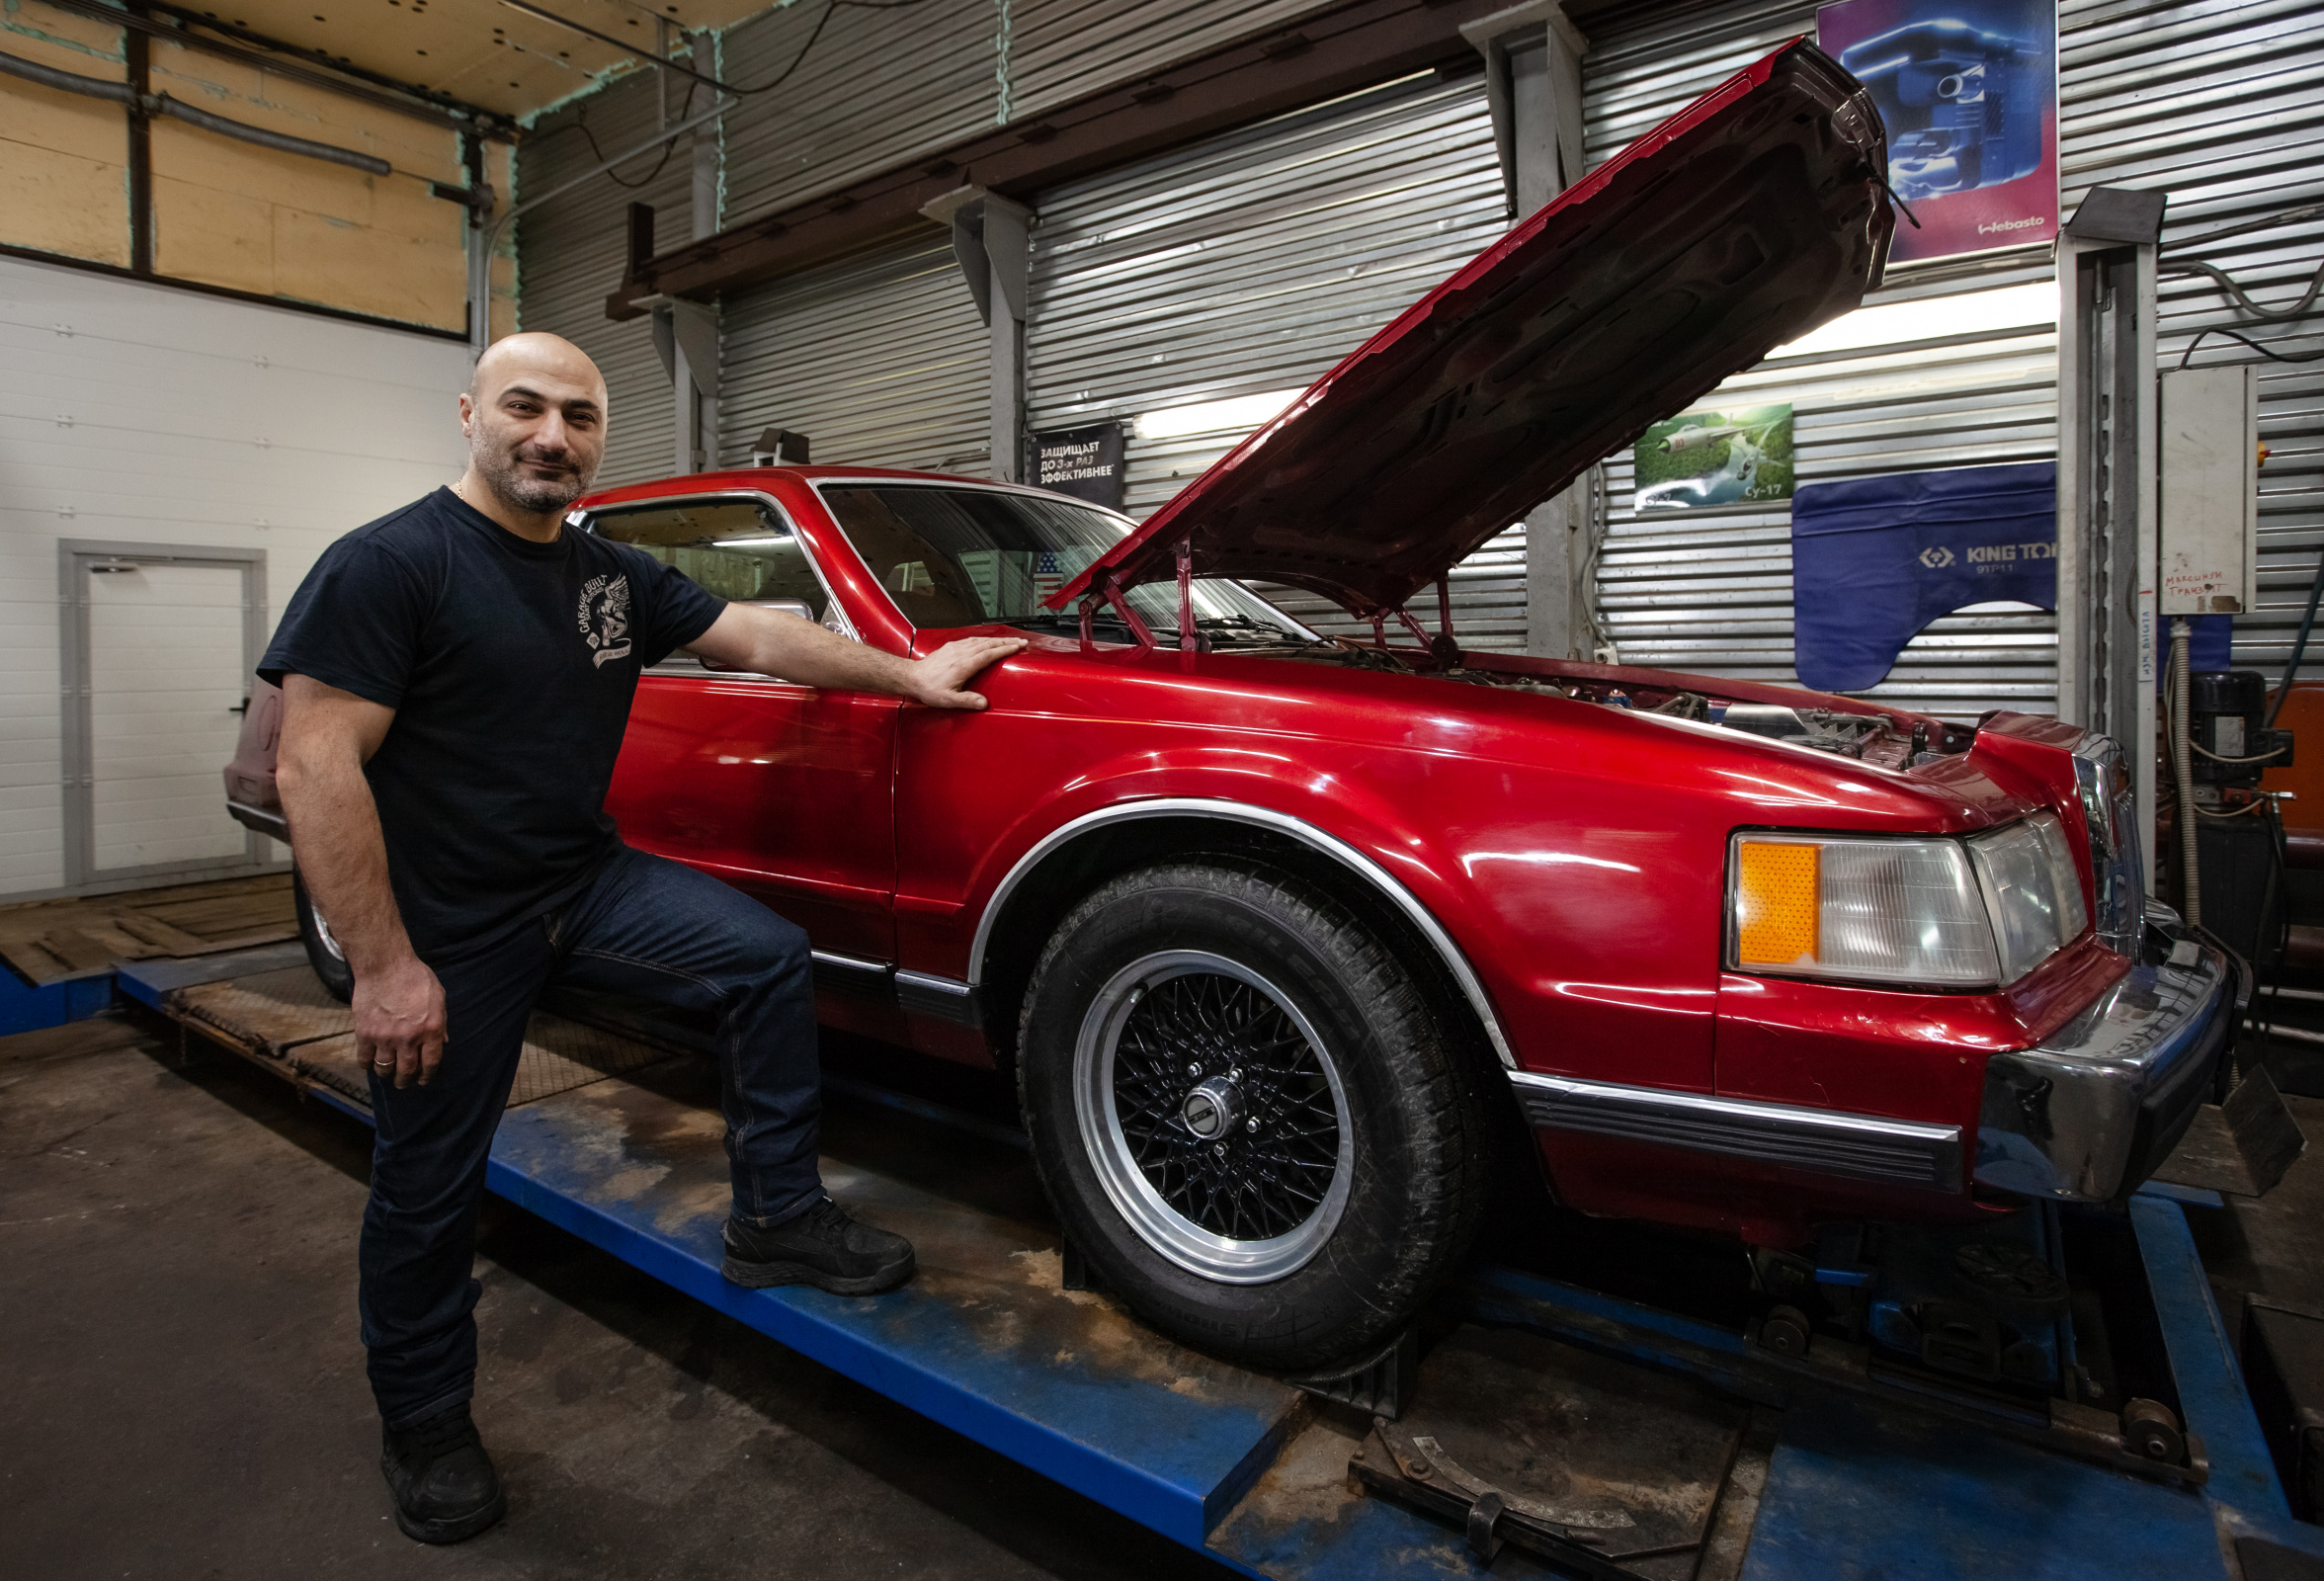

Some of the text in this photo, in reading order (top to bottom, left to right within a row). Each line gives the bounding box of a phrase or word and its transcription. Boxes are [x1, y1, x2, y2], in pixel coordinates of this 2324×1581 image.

[1978, 215, 2044, 235] Webasto
[1040, 441, 1100, 458] ЗАЩИЩАЕТ
[1040, 459, 1055, 473] ДО
[1075, 456, 1094, 467] РАЗ
[1966, 544, 2016, 563] KING
[578, 574, 608, 632] GARAGE BUILT
